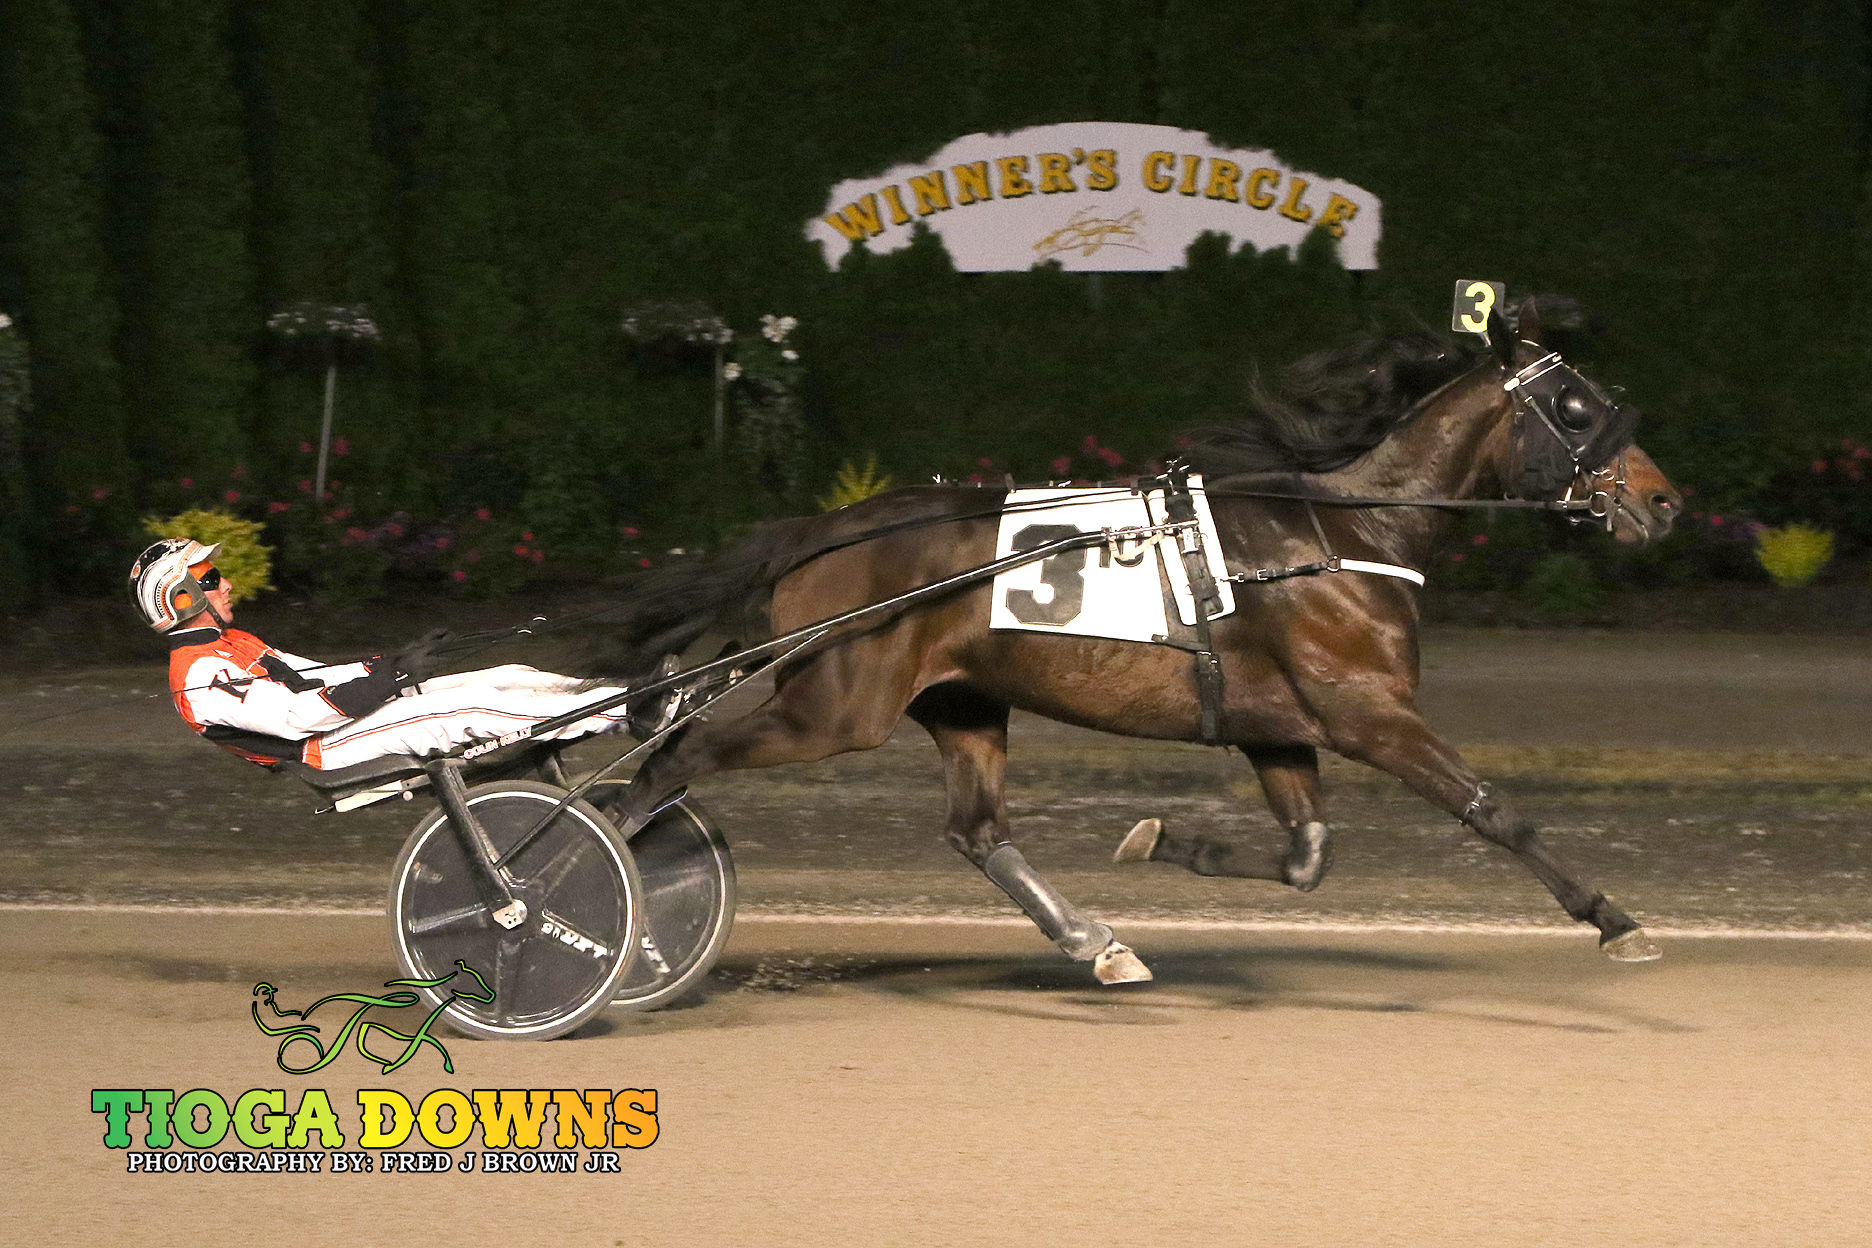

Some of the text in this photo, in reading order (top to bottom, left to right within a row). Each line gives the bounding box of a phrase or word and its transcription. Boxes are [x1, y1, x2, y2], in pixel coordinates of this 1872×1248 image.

[825, 147, 1359, 241] WINNER'S CIRCLE
[1461, 281, 1495, 333] 3
[1006, 524, 1088, 627] 3
[464, 739, 499, 759] COLIN
